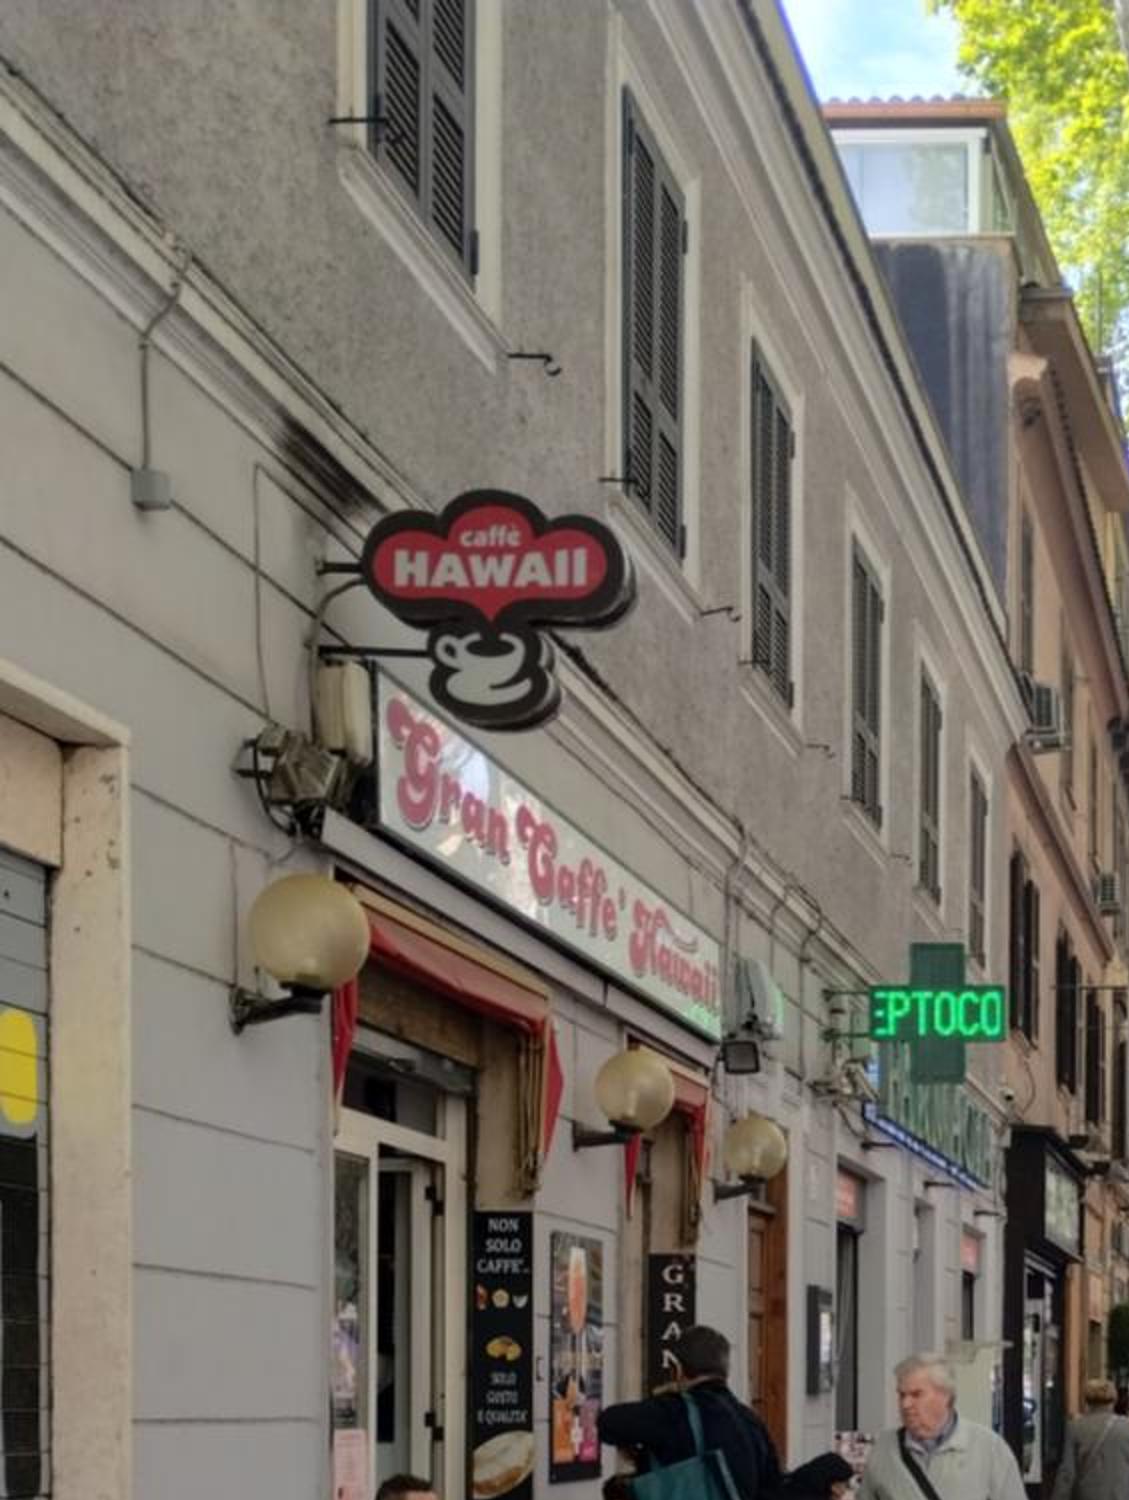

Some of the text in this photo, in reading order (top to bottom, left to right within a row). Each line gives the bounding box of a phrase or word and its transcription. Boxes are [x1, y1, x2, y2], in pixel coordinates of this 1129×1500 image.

[394, 547, 588, 588] HAWAII
[386, 697, 512, 867] Gran
[487, 1217, 520, 1232] NON
[485, 1238, 523, 1253] SOLO
